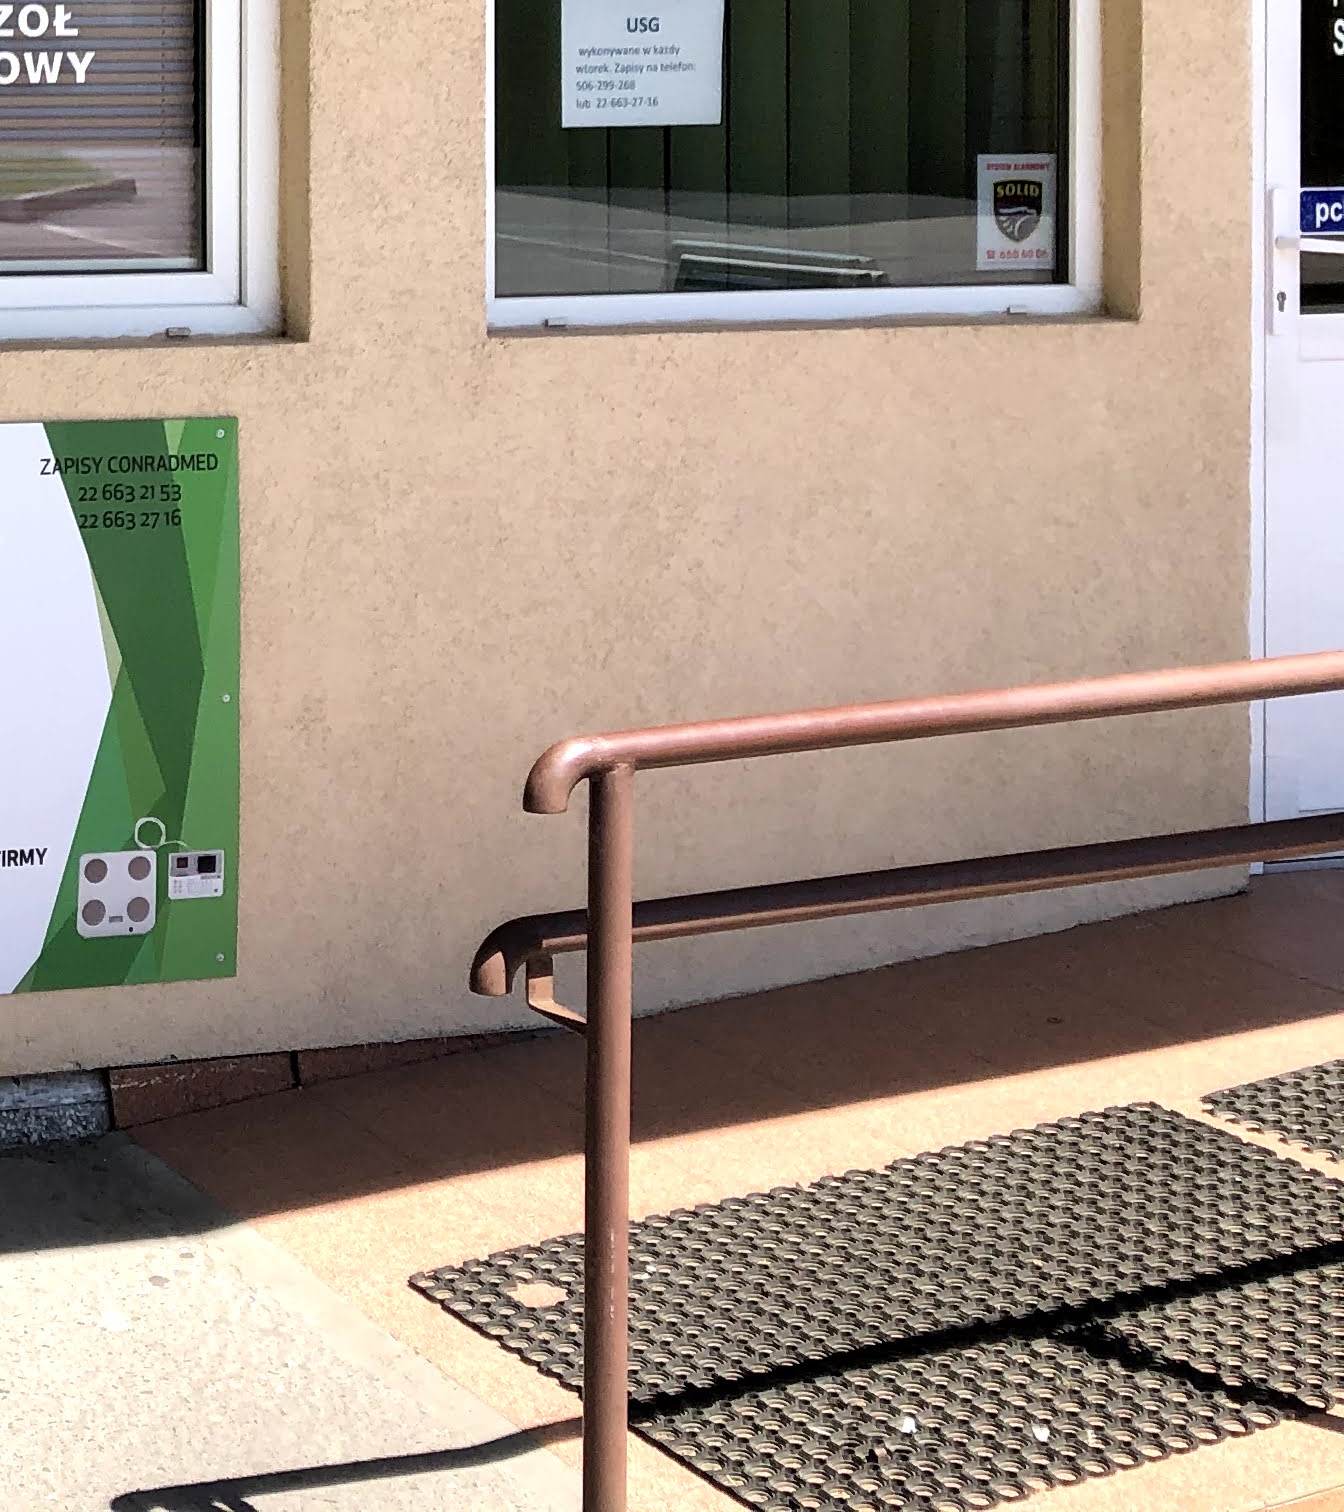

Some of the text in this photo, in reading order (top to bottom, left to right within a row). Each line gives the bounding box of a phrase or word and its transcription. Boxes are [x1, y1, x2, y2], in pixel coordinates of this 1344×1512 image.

[627, 17, 660, 33] USG
[578, 45, 640, 58] wykonywane
[643, 48, 651, 56] w
[614, 62, 644, 75] Zapisy
[997, 183, 1040, 199] SOLID
[40, 453, 218, 475] ZAPISY CONRADMED
[78, 484, 181, 503] 22 663 21 53
[80, 509, 181, 530] 22 663 27 16
